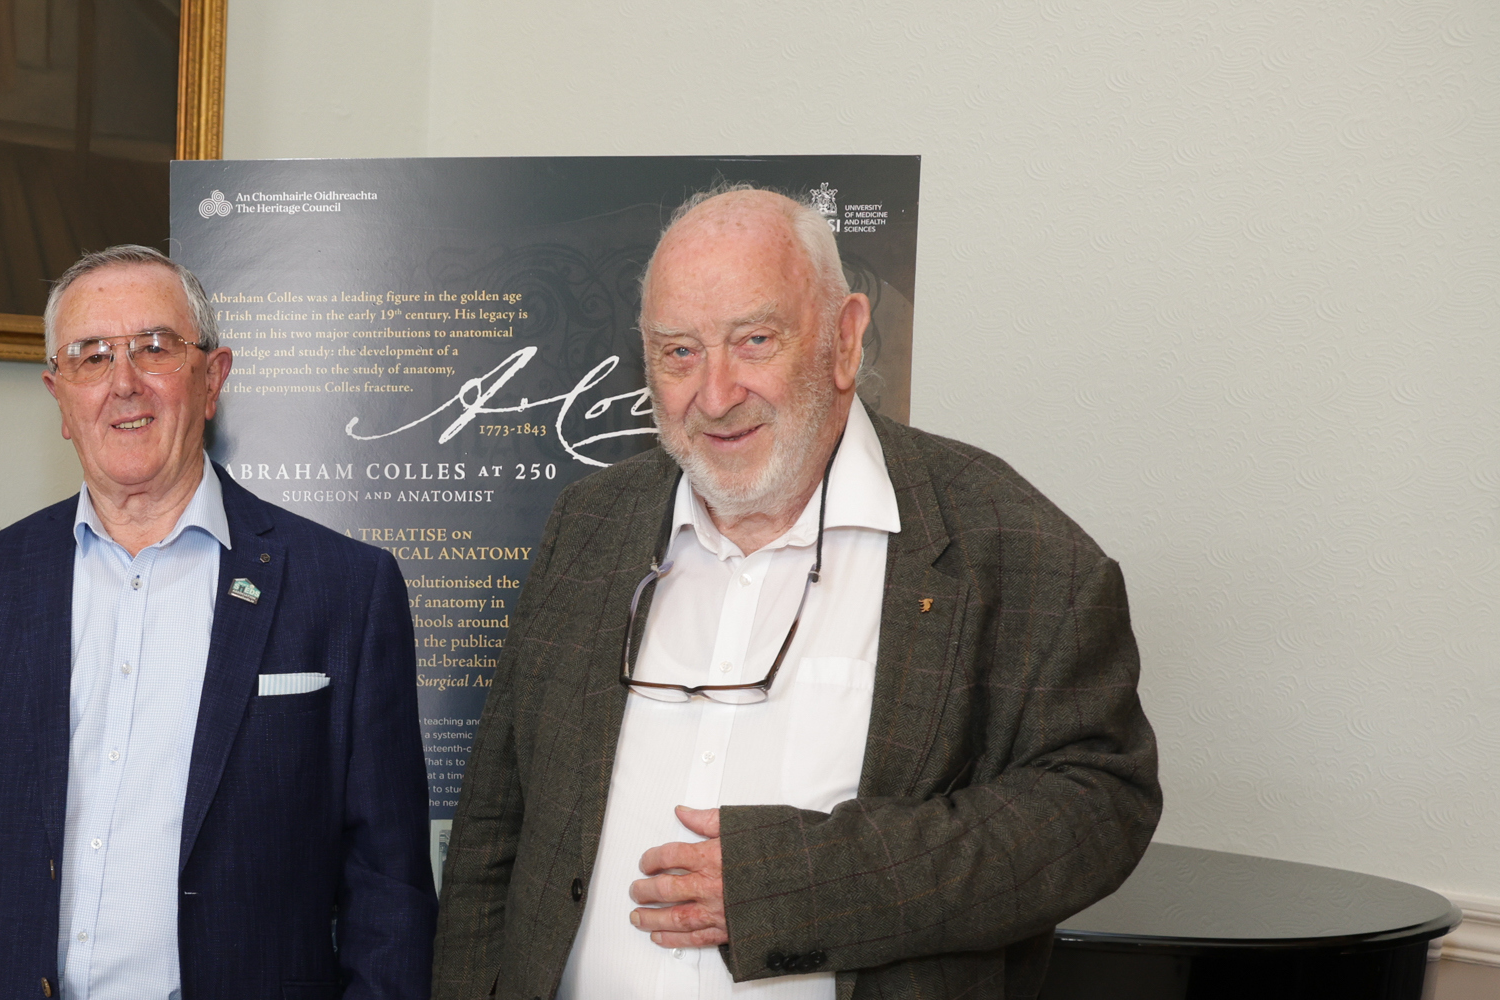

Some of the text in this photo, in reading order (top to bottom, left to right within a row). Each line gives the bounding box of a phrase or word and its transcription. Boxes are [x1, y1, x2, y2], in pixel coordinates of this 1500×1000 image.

[235, 190, 378, 202] An Chomhairle Oidhreachta
[235, 203, 341, 215] The Heritage Council
[828, 219, 841, 233] SI
[210, 292, 264, 303] Abraham
[267, 292, 303, 303] Colles
[341, 291, 383, 305] leading
[386, 291, 421, 305] figure
[424, 292, 434, 302] in
[438, 290, 457, 302] the
[460, 290, 500, 305] golden
[503, 292, 522, 304] age
[225, 310, 252, 321] Irish
[256, 310, 308, 321] medicine
[311, 310, 323, 320] in
[326, 309, 345, 320] the
[348, 309, 376, 323] early
[380, 309, 402, 320] 19th
[405, 310, 451, 323] century.
[454, 309, 476, 319] His
[479, 309, 515, 323] legacy
[518, 309, 528, 319] is
[218, 326, 513, 342] vident in his two major contributions to anatomical
[232, 344, 459, 360] wledge and study: the development of a
[228, 363, 456, 378] onal approach to the study of anatomy,
[234, 382, 252, 393] the
[255, 384, 322, 396] eponymous
[324, 381, 361, 393] Colles
[364, 381, 414, 393] fracture.
[479, 423, 547, 437] 1773-1843
[224, 462, 557, 480] ABRAHAM COLLES AT 250
[282, 489, 494, 502] SURGEON AND ANATOMIST
[358, 528, 448, 542] TREATISE
[452, 530, 473, 540] ON
[381, 547, 532, 560] ICAL ANATOMY
[404, 575, 520, 589] volutionised the
[425, 598, 487, 613] anatomy
[490, 595, 505, 608] in
[412, 614, 510, 628] hools around
[424, 634, 447, 648] the
[417, 653, 499, 668] nd-breakin
[416, 673, 493, 691] Surgical An
[423, 717, 464, 727] teaching
[433, 731, 473, 740] systemic
[422, 744, 472, 753] ixteenth-c
[445, 757, 453, 766] is
[456, 758, 466, 766] to
[427, 772, 436, 780] at
